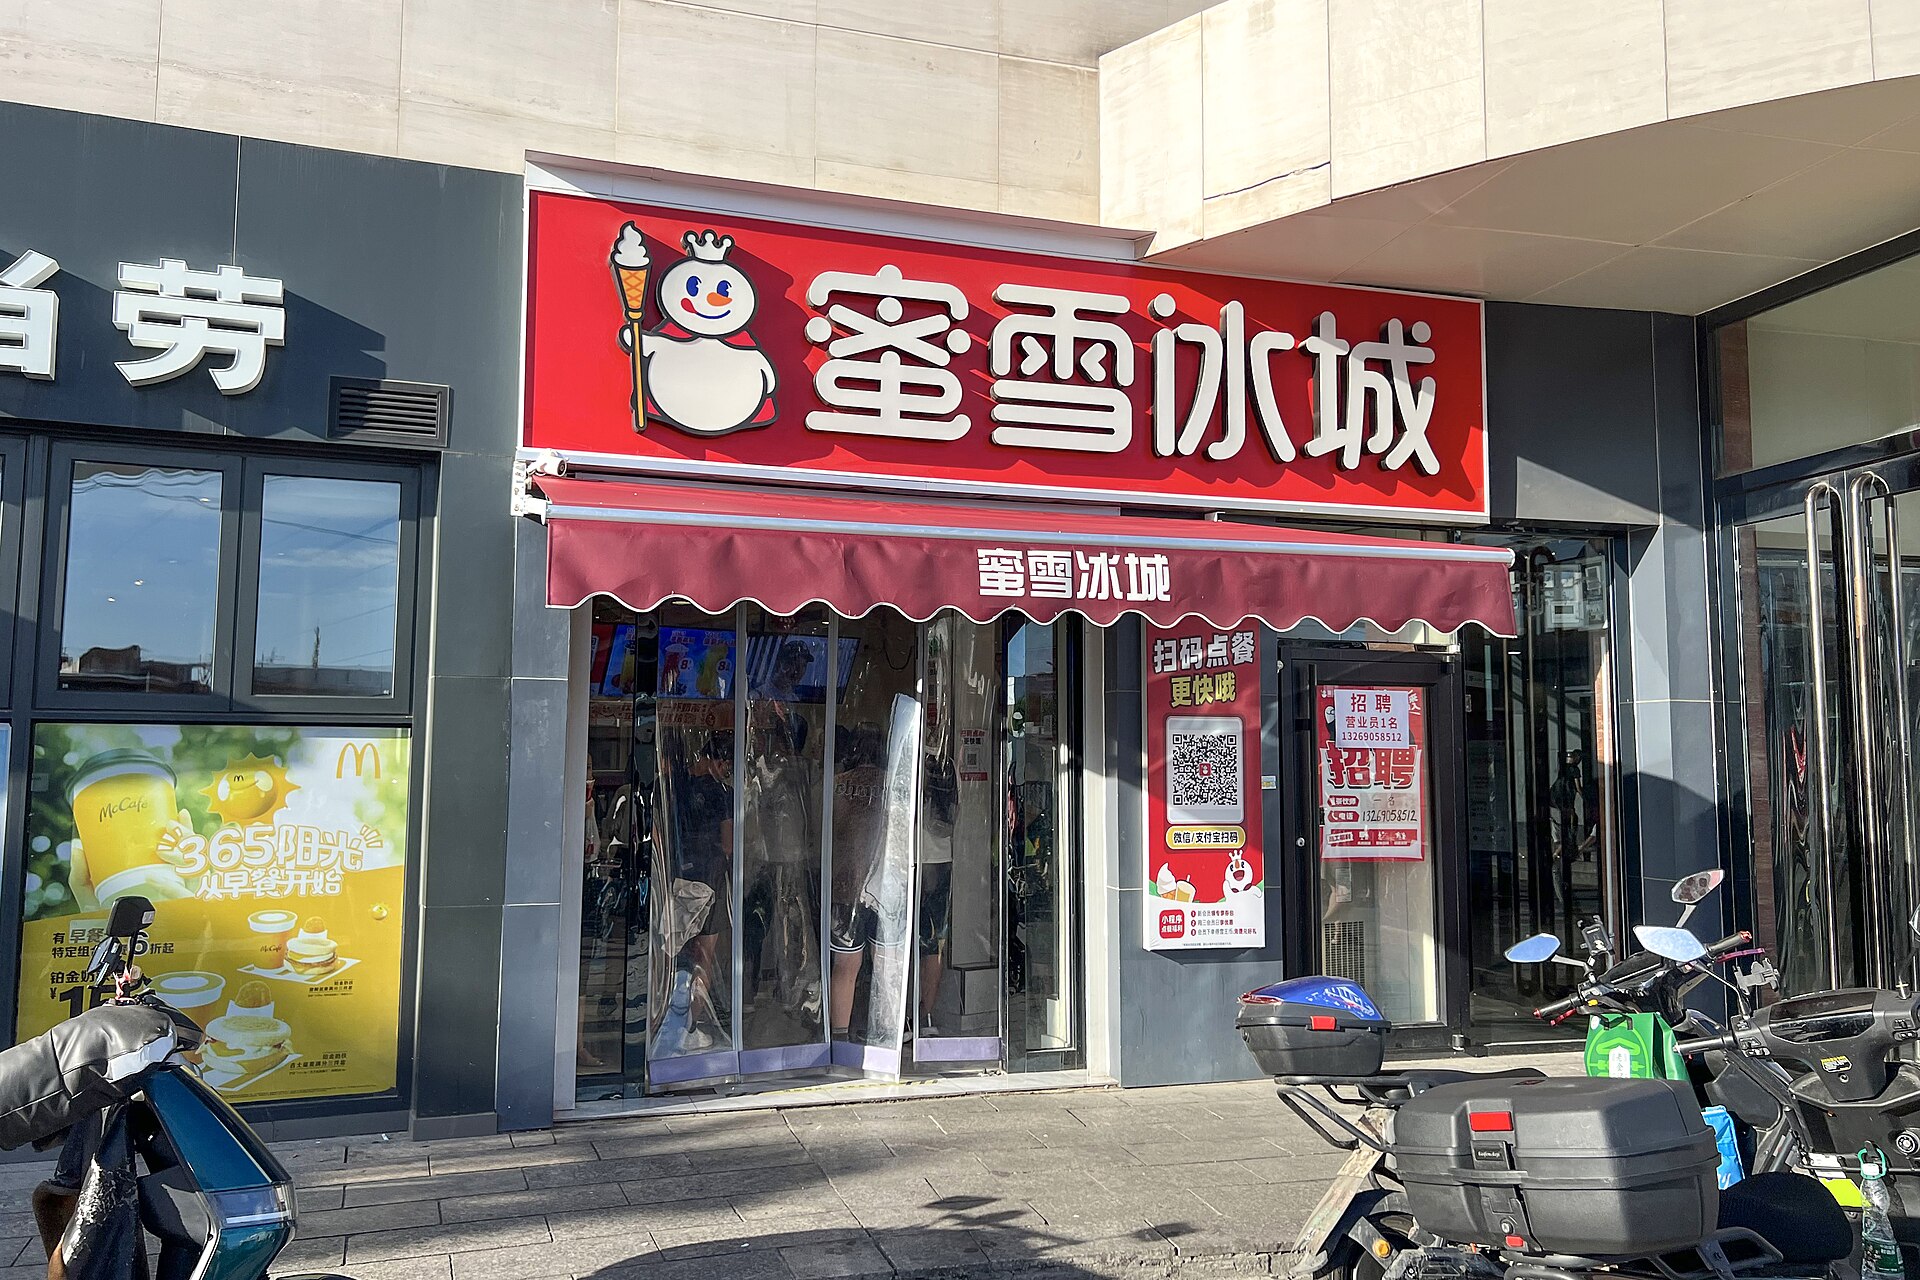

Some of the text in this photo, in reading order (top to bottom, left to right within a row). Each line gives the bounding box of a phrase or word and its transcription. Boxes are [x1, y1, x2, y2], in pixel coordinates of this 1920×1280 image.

[804, 264, 1440, 476] 蜜雪冰城
[977, 547, 1171, 602] 蜜雪冰城
[1153, 631, 1255, 673] 扫码点餐
[1170, 671, 1236, 707] 更快哦
[1350, 693, 1392, 713] 招聘
[1342, 732, 1402, 742] 13269058512
[1345, 716, 1398, 729] 营业员1名
[1325, 742, 1418, 790] 招聘
[174, 824, 365, 875] 365阳光
[1173, 831, 1238, 844] 微信/支付宝扫码
[194, 867, 344, 899] 从早餐开始
